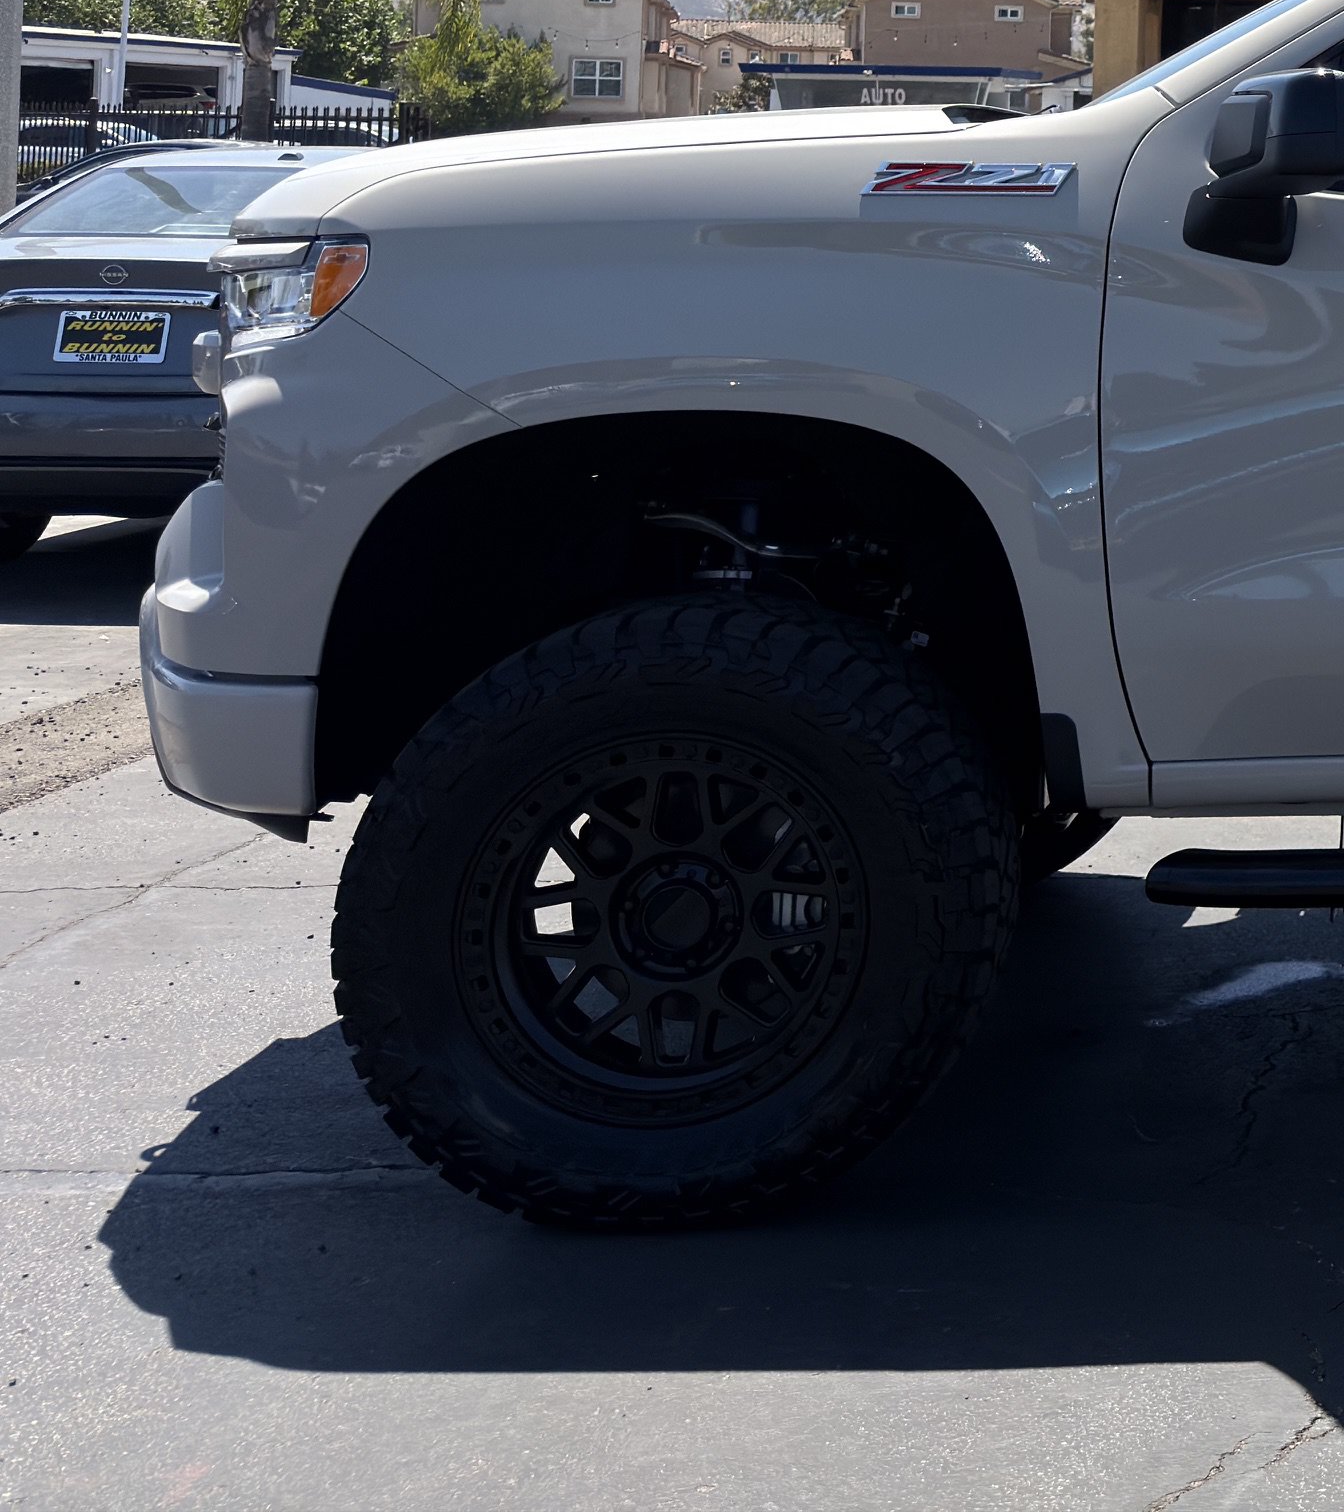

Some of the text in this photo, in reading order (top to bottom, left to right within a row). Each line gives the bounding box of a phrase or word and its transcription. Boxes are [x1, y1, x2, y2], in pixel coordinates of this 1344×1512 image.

[860, 88, 906, 105] AUTO
[860, 160, 1078, 196] Z71
[88, 311, 142, 321] BUNNIN
[66, 321, 163, 331] RUNNIN'
[102, 332, 127, 341] to
[62, 343, 156, 353] BUNNIN
